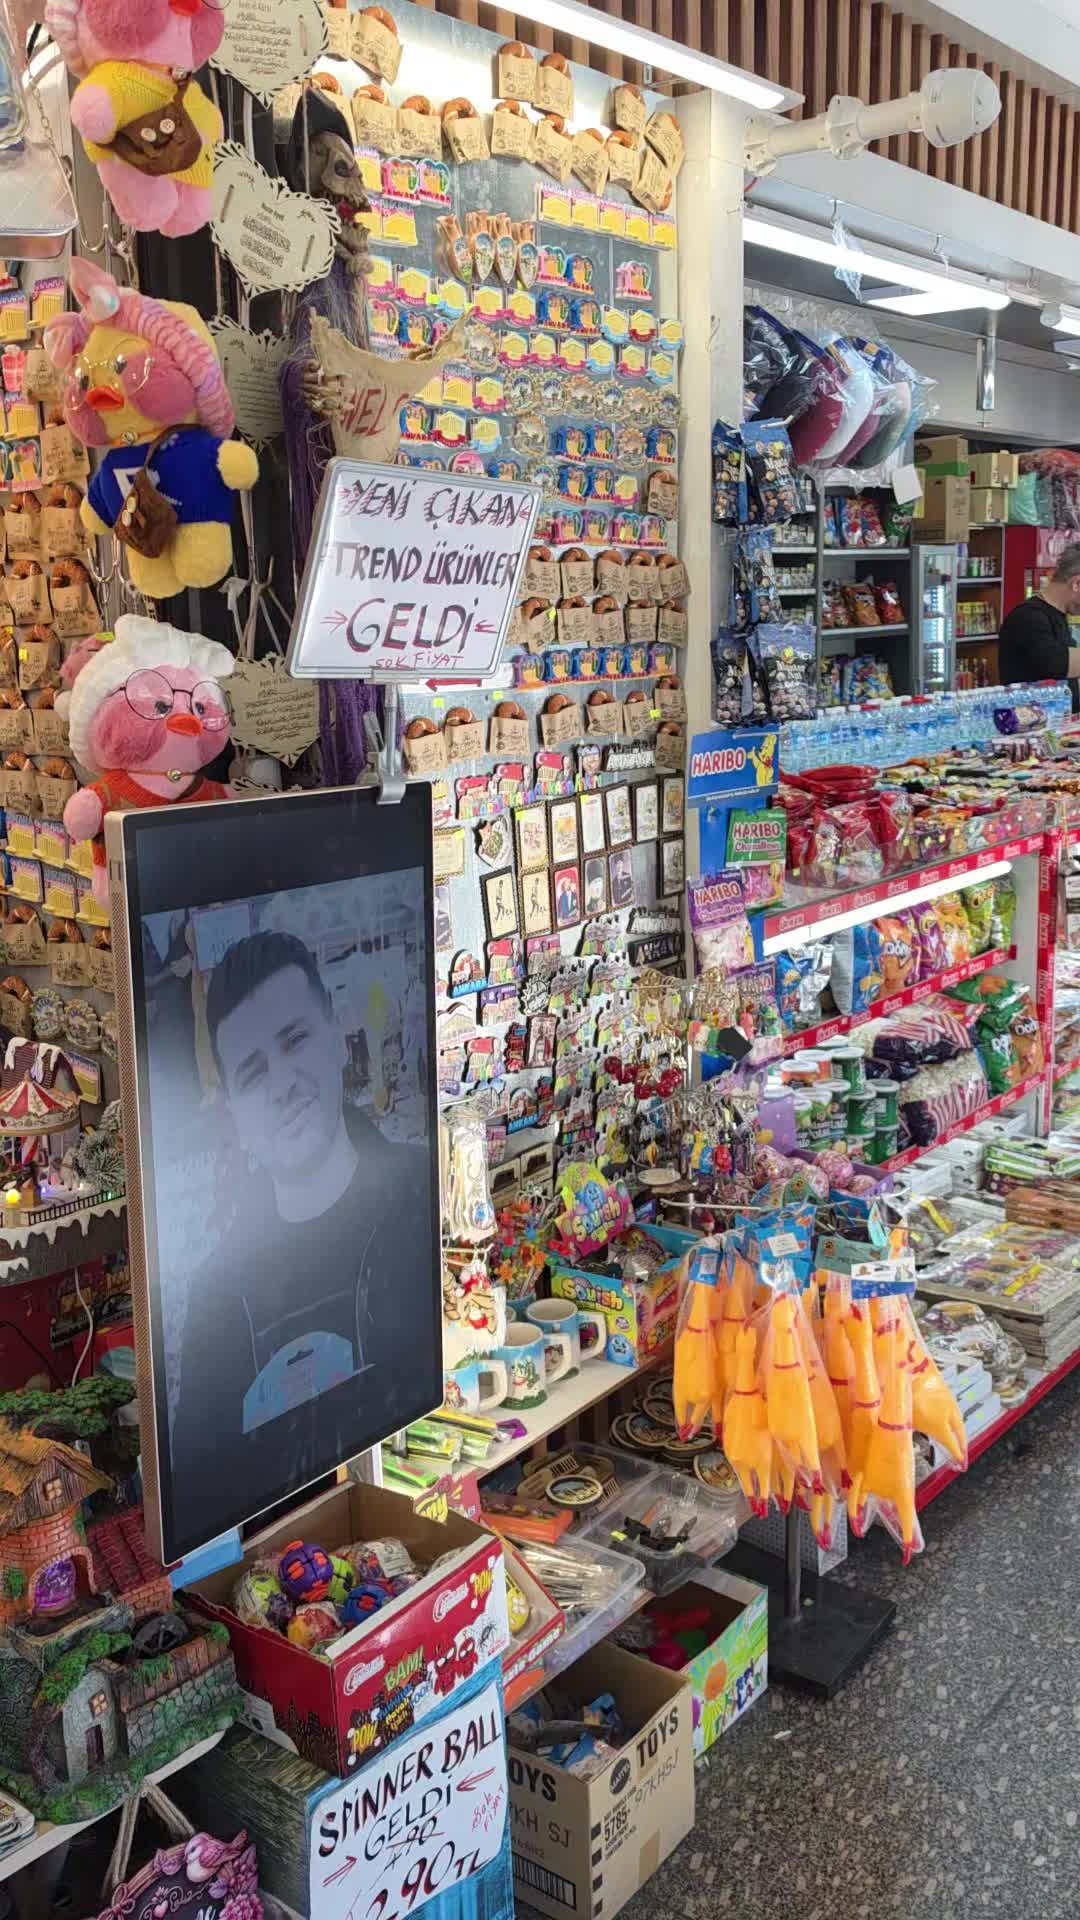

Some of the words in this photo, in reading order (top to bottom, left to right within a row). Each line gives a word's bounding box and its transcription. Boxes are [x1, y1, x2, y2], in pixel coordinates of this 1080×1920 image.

[424, 487, 524, 531] ÇIKAN
[334, 542, 422, 582] TREND
[424, 541, 518, 590] ÜRÜNLER
[691, 747, 746, 778] HARIBO
[733, 822, 781, 839] HARIBO
[694, 881, 741, 905] HARIBO
[384, 1645, 425, 1692] BAM!
[351, 1721, 378, 1753] POW!
[441, 1710, 502, 1774] BALL
[636, 1706, 680, 1768] TOYS
[508, 1757, 557, 1803] OYS
[364, 1776, 453, 1862] GELDİ
